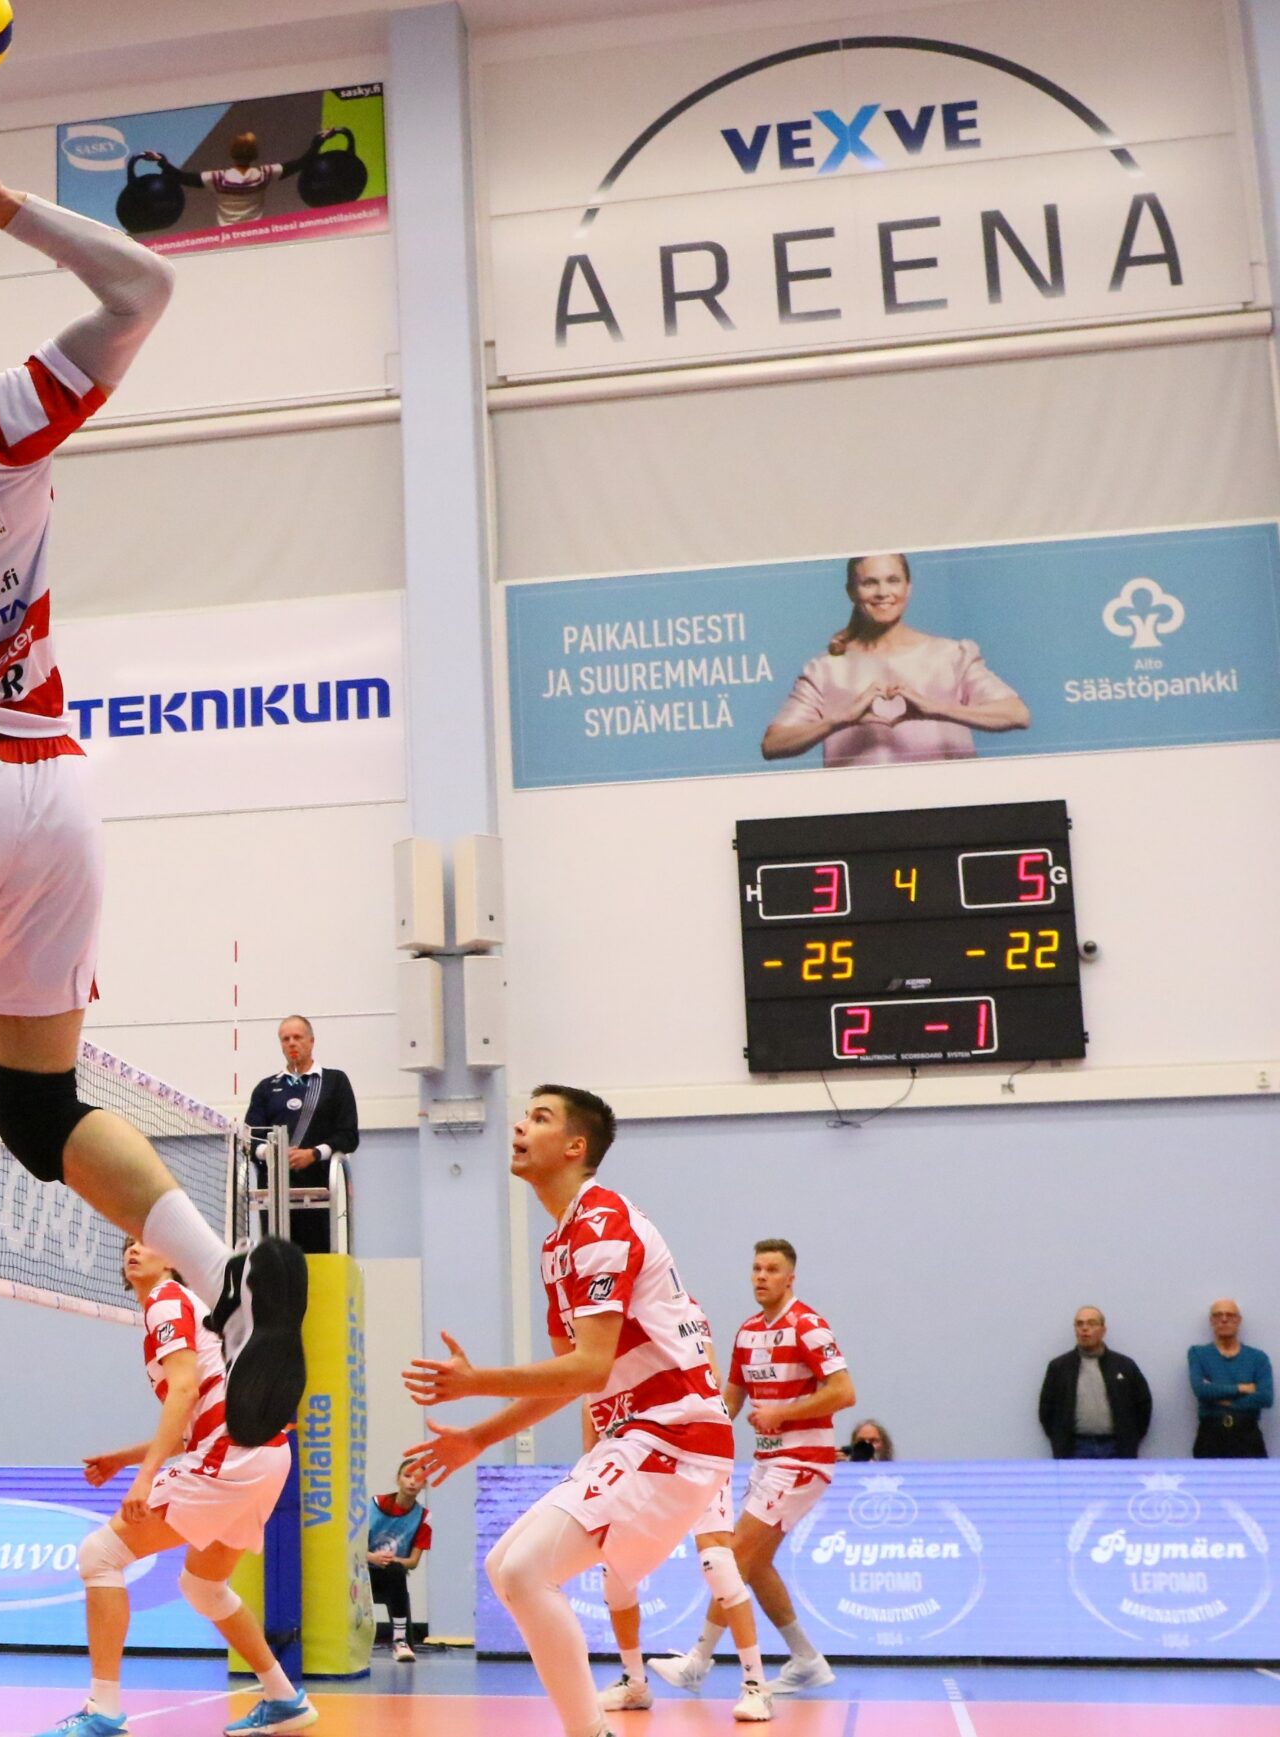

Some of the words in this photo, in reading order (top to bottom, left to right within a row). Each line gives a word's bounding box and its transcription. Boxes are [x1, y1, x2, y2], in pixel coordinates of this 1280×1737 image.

[340, 84, 381, 99] sasky.fi
[720, 100, 981, 175] VEXVE
[554, 192, 1184, 349] AREENA
[563, 613, 746, 655] PAIKALLISESTI
[542, 667, 572, 699] JA
[580, 654, 773, 695] SUUREMMALLA
[1135, 659, 1163, 671] Aito
[1064, 669, 1238, 703] Säästöpankki
[68, 676, 391, 740] TEKNIKUM
[584, 700, 734, 738] SYDÄMELLÄ
[746, 884, 761, 902] H
[813, 866, 840, 913] 3
[895, 868, 917, 902] 4
[1019, 854, 1045, 901] 5
[1049, 866, 1068, 885] G
[802, 941, 854, 981] 25
[1006, 930, 1059, 970] 22
[842, 1008, 871, 1055] 2
[979, 1003, 988, 1048] 1
[302, 1393, 333, 1529] Väriaitta
[599, 1461, 625, 1487] 11
[811, 1529, 961, 1566] Pyymäen
[1091, 1528, 1247, 1565] Pyymäen
[850, 1571, 922, 1593] LEIPOMO
[1132, 1571, 1208, 1594] LEIPOMO
